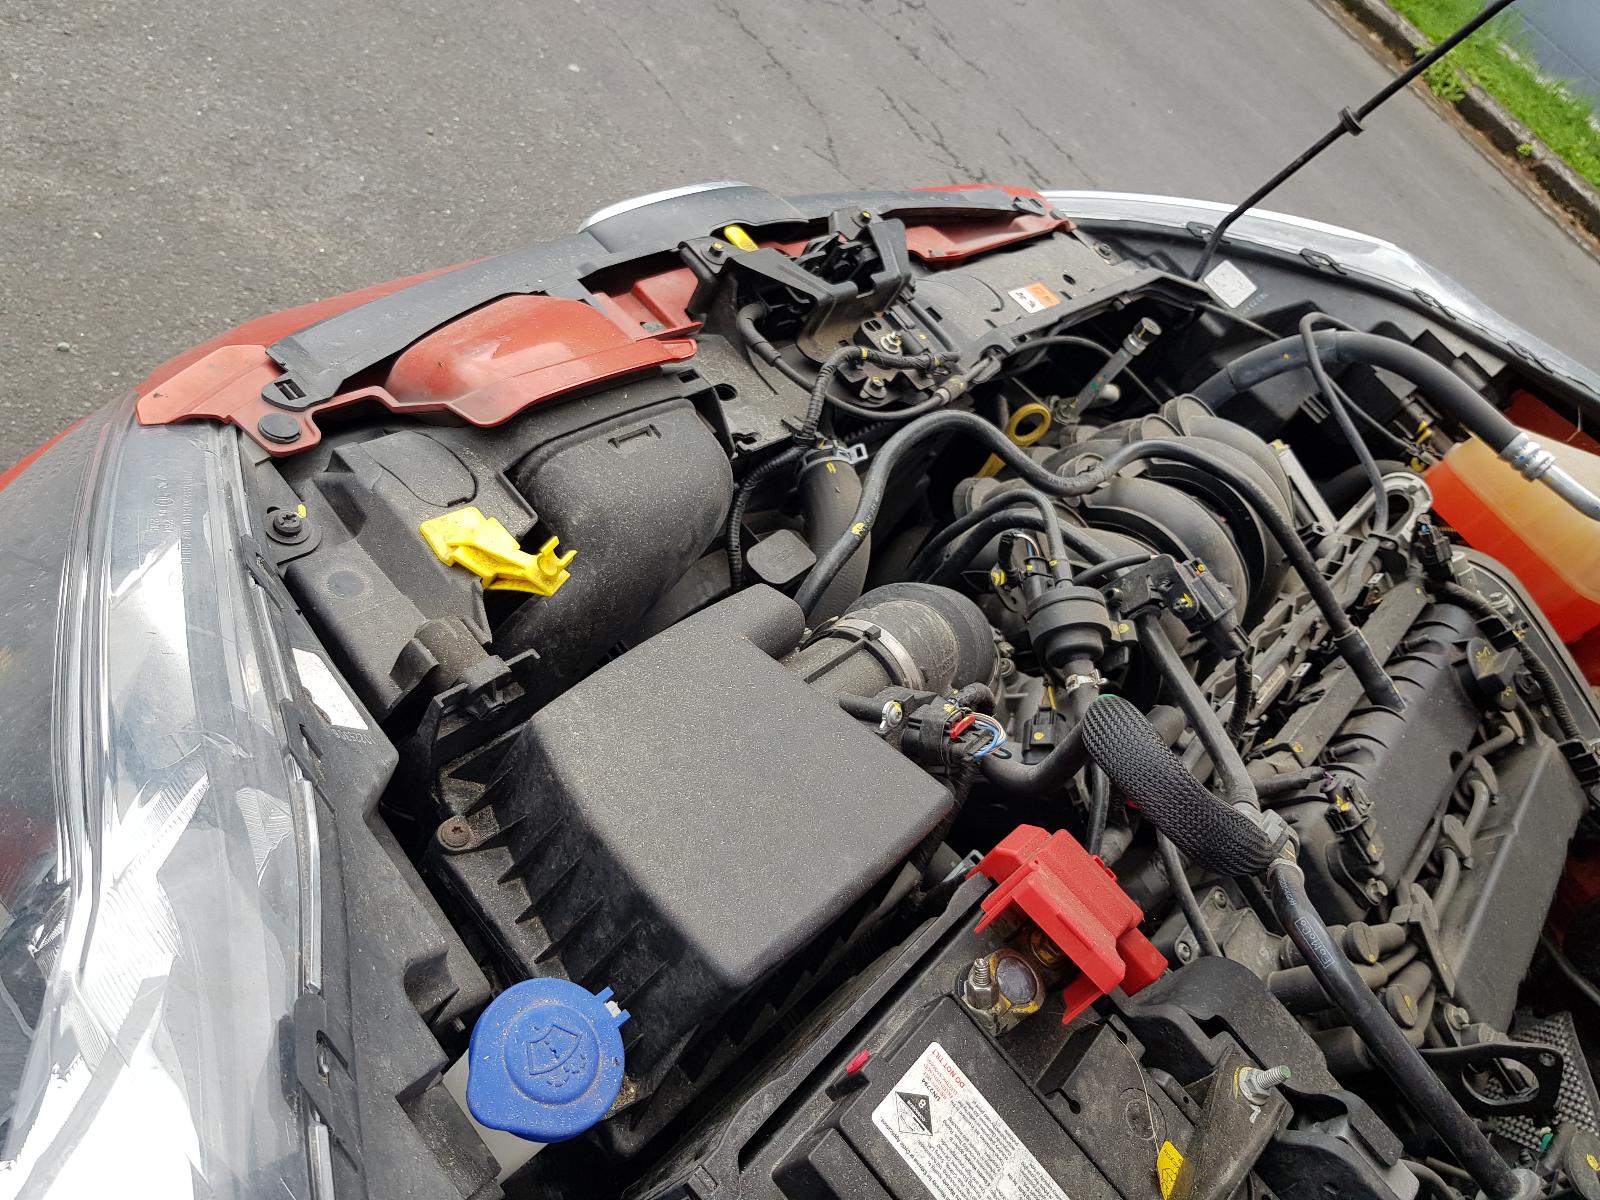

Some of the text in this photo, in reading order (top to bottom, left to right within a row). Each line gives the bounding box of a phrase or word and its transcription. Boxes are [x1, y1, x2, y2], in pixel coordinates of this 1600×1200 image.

[930, 1047, 966, 1088] DO NOT TILT
[915, 1097, 928, 1109] 8
